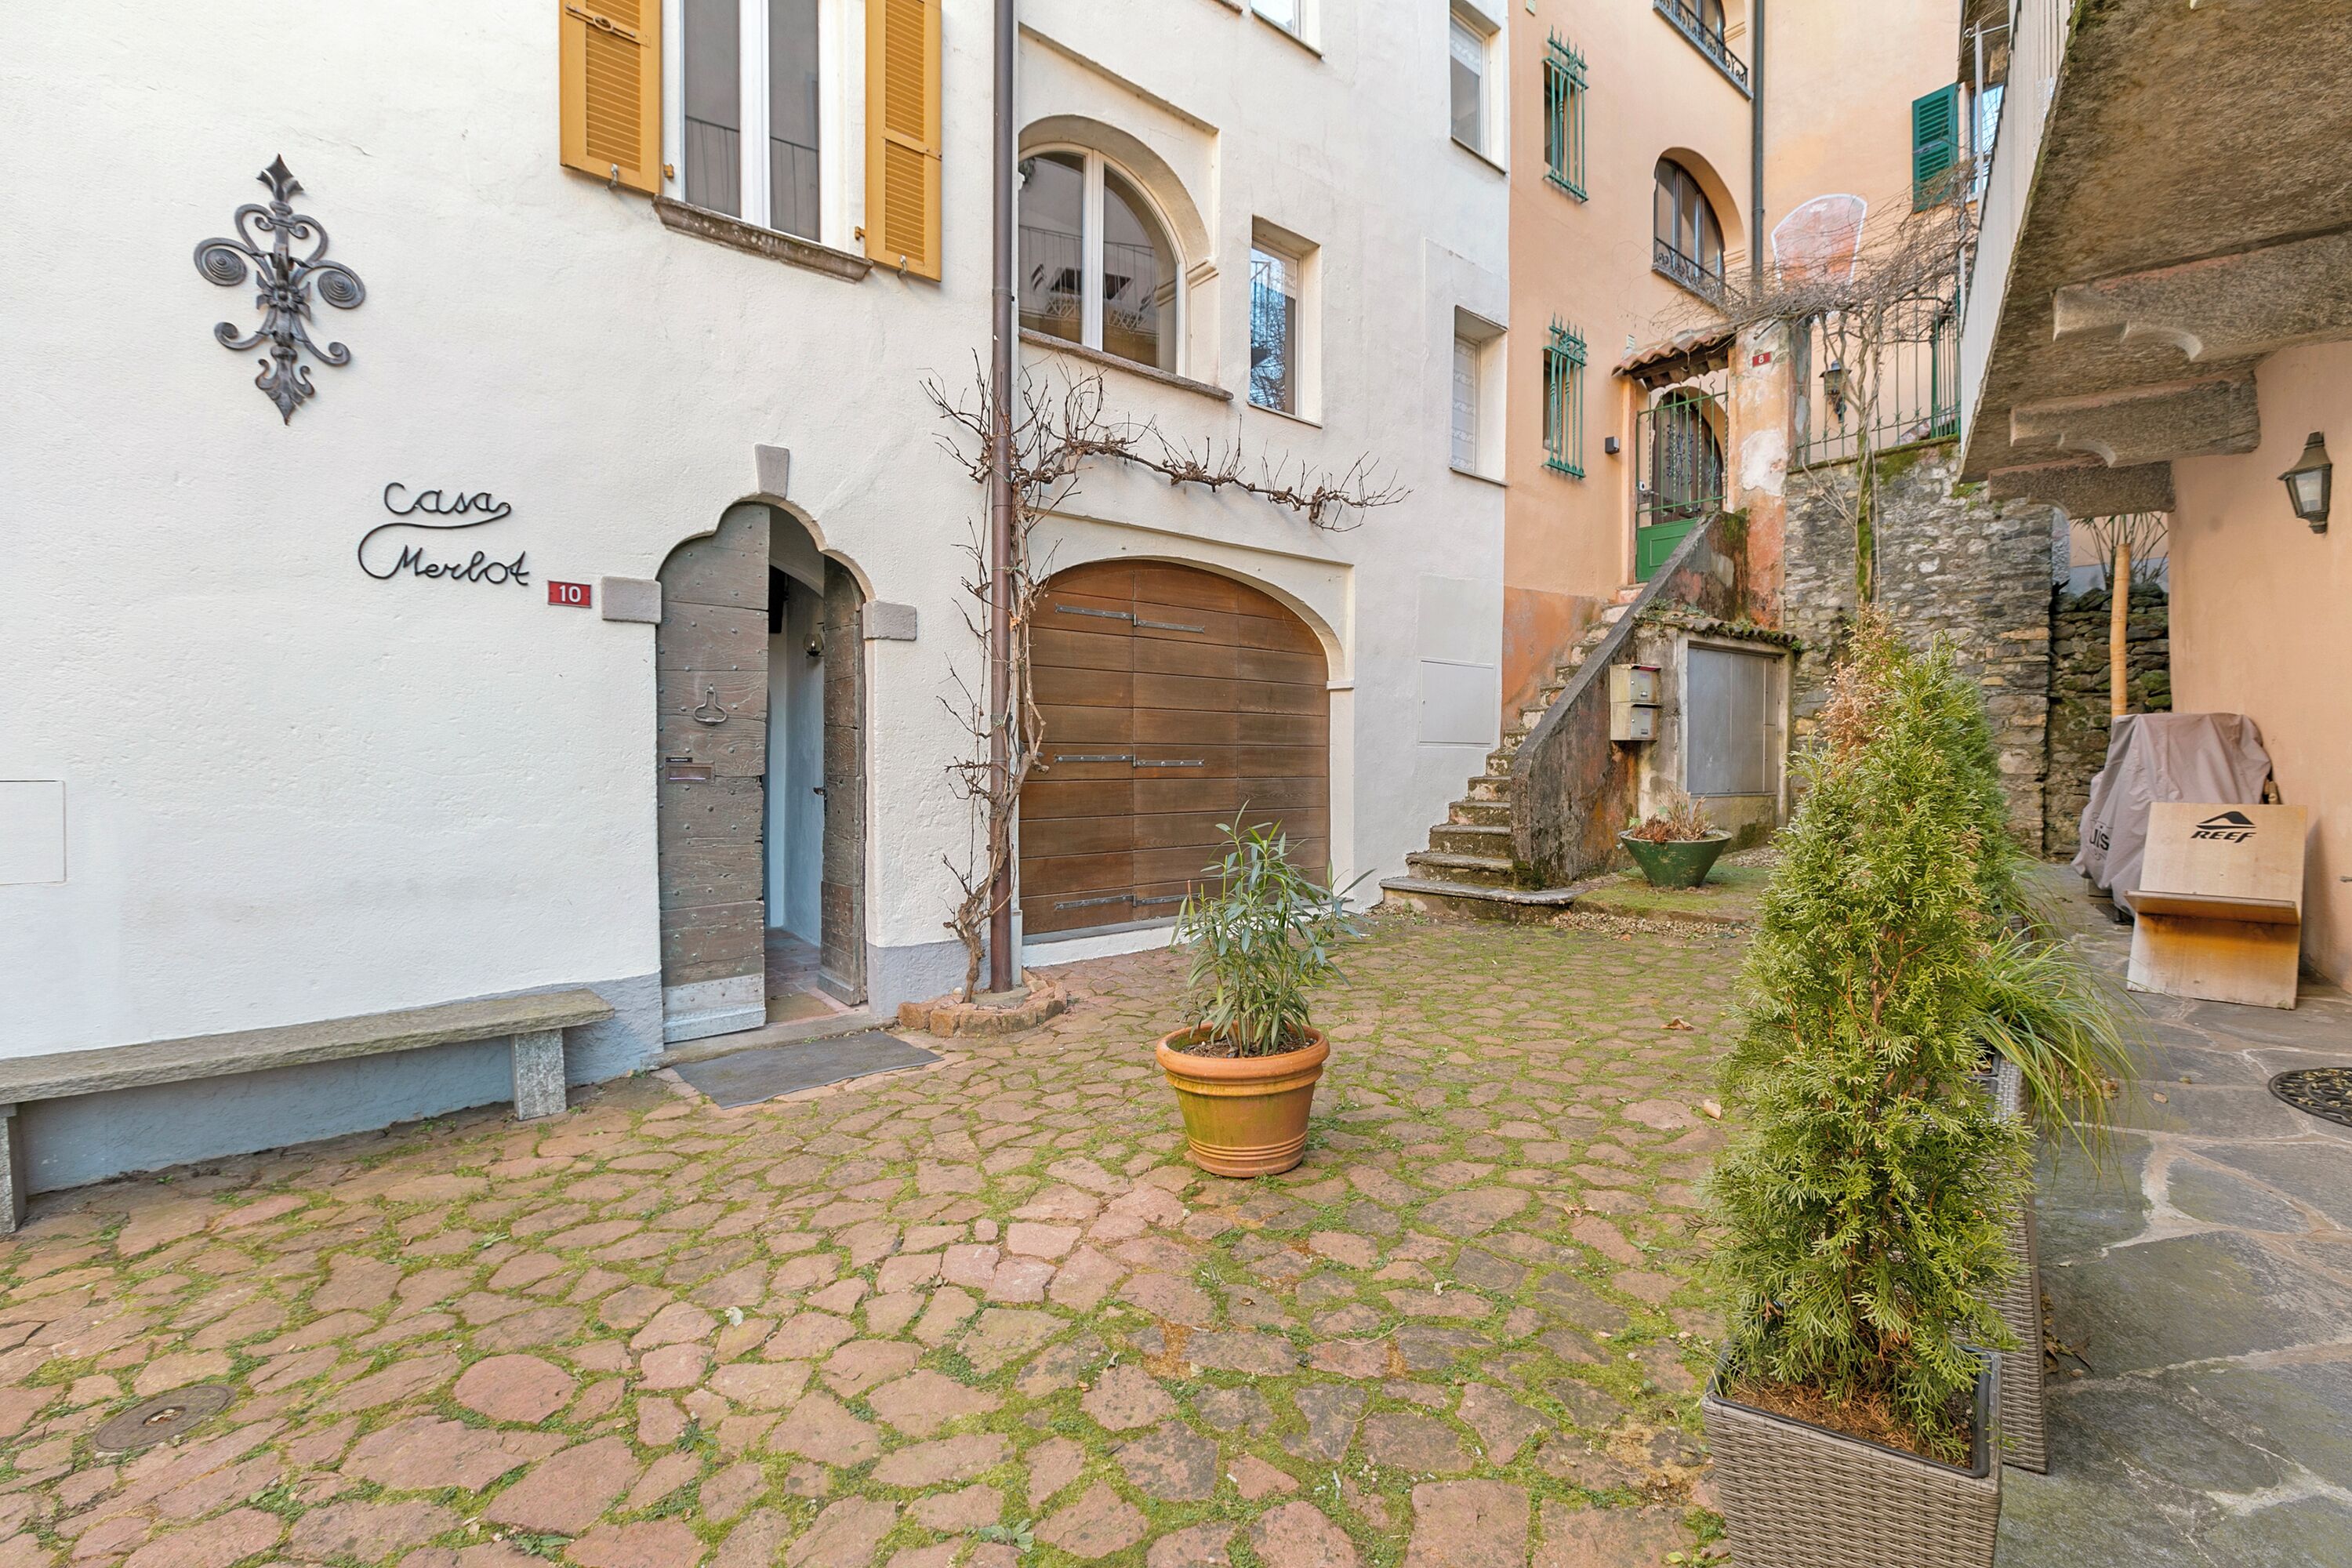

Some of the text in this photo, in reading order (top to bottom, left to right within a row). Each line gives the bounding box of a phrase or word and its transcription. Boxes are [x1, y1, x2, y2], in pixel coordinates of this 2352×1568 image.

[1758, 354, 1764, 364] 8
[384, 482, 511, 515] Casa
[361, 541, 530, 586] Merlot
[559, 585, 582, 603] 10
[2190, 830, 2257, 844] REEF
